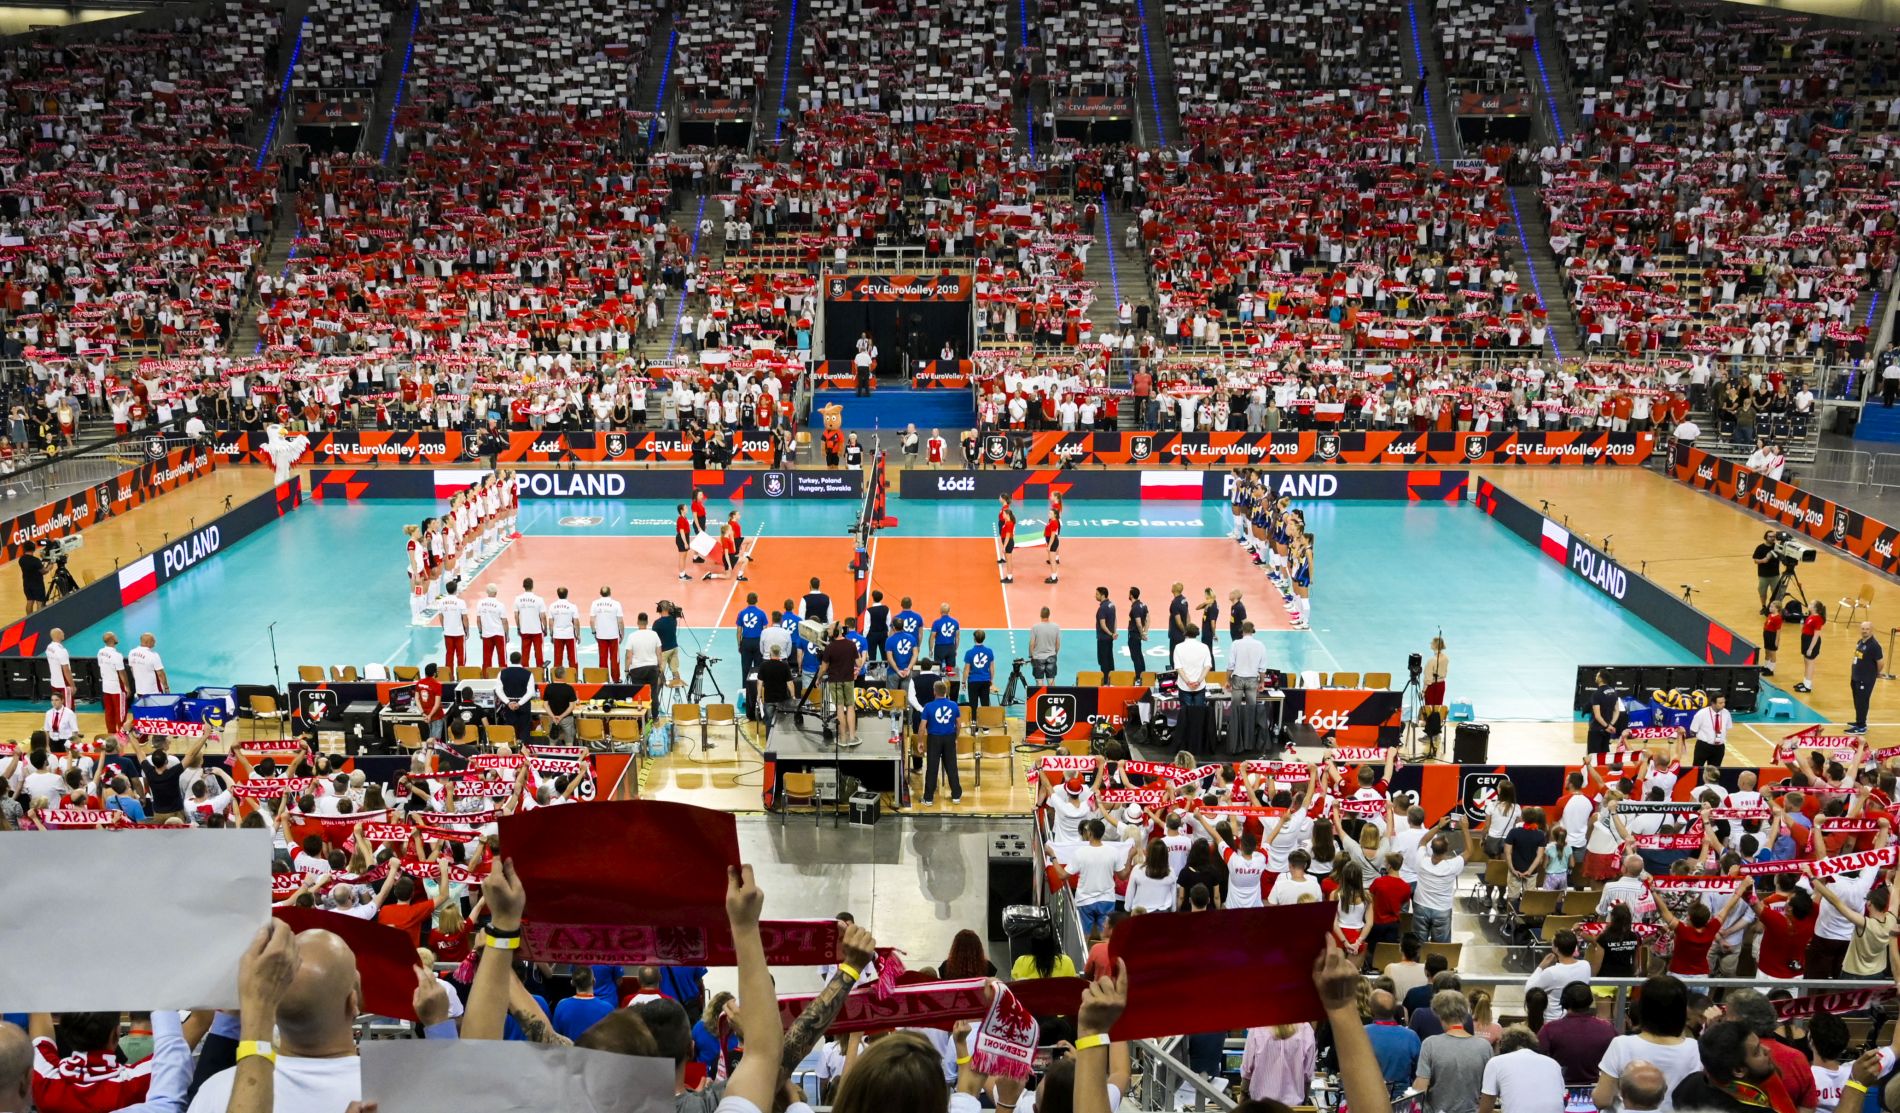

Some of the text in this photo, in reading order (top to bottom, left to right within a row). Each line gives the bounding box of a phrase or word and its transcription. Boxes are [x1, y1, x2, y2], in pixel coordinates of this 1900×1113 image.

[860, 284, 959, 296] CEV EuroVolley 2019
[214, 441, 240, 455] Łódź
[324, 443, 446, 458] CEV EuroVolley 2019
[531, 441, 560, 453] Łódź
[645, 441, 671, 452] CEV
[741, 441, 770, 452] 2019
[1054, 441, 1084, 455] Łódź
[1171, 443, 1298, 458] CEV EuroVolley 2019
[1387, 441, 1417, 455] Łódź
[1506, 443, 1635, 458] CEV EuroVolley 2019
[153, 455, 208, 486] CEV EuroVolley 2019
[517, 473, 626, 496] POLAND
[798, 477, 820, 486] Turkey,
[798, 485, 825, 493] Hungary,
[938, 476, 975, 491] Łódź
[1223, 474, 1338, 497] PAND
[118, 487, 133, 502] Łódź
[1755, 487, 1823, 527] CEV EuroVolley 2019
[13, 503, 89, 545] CEV EuroVolley 2019
[1017, 518, 1205, 528] #VsitPoland
[163, 525, 220, 578] POLAND
[1874, 537, 1894, 558] Łódź
[1572, 542, 1627, 600] POLAND
[1295, 709, 1350, 731] Łódź
[530, 758, 581, 774] OLSKA
[1125, 761, 1186, 779] POL SK
[1476, 777, 1498, 785] CEV
[1675, 837, 1702, 845] SKA
[1815, 1089, 1842, 1100] POLS
